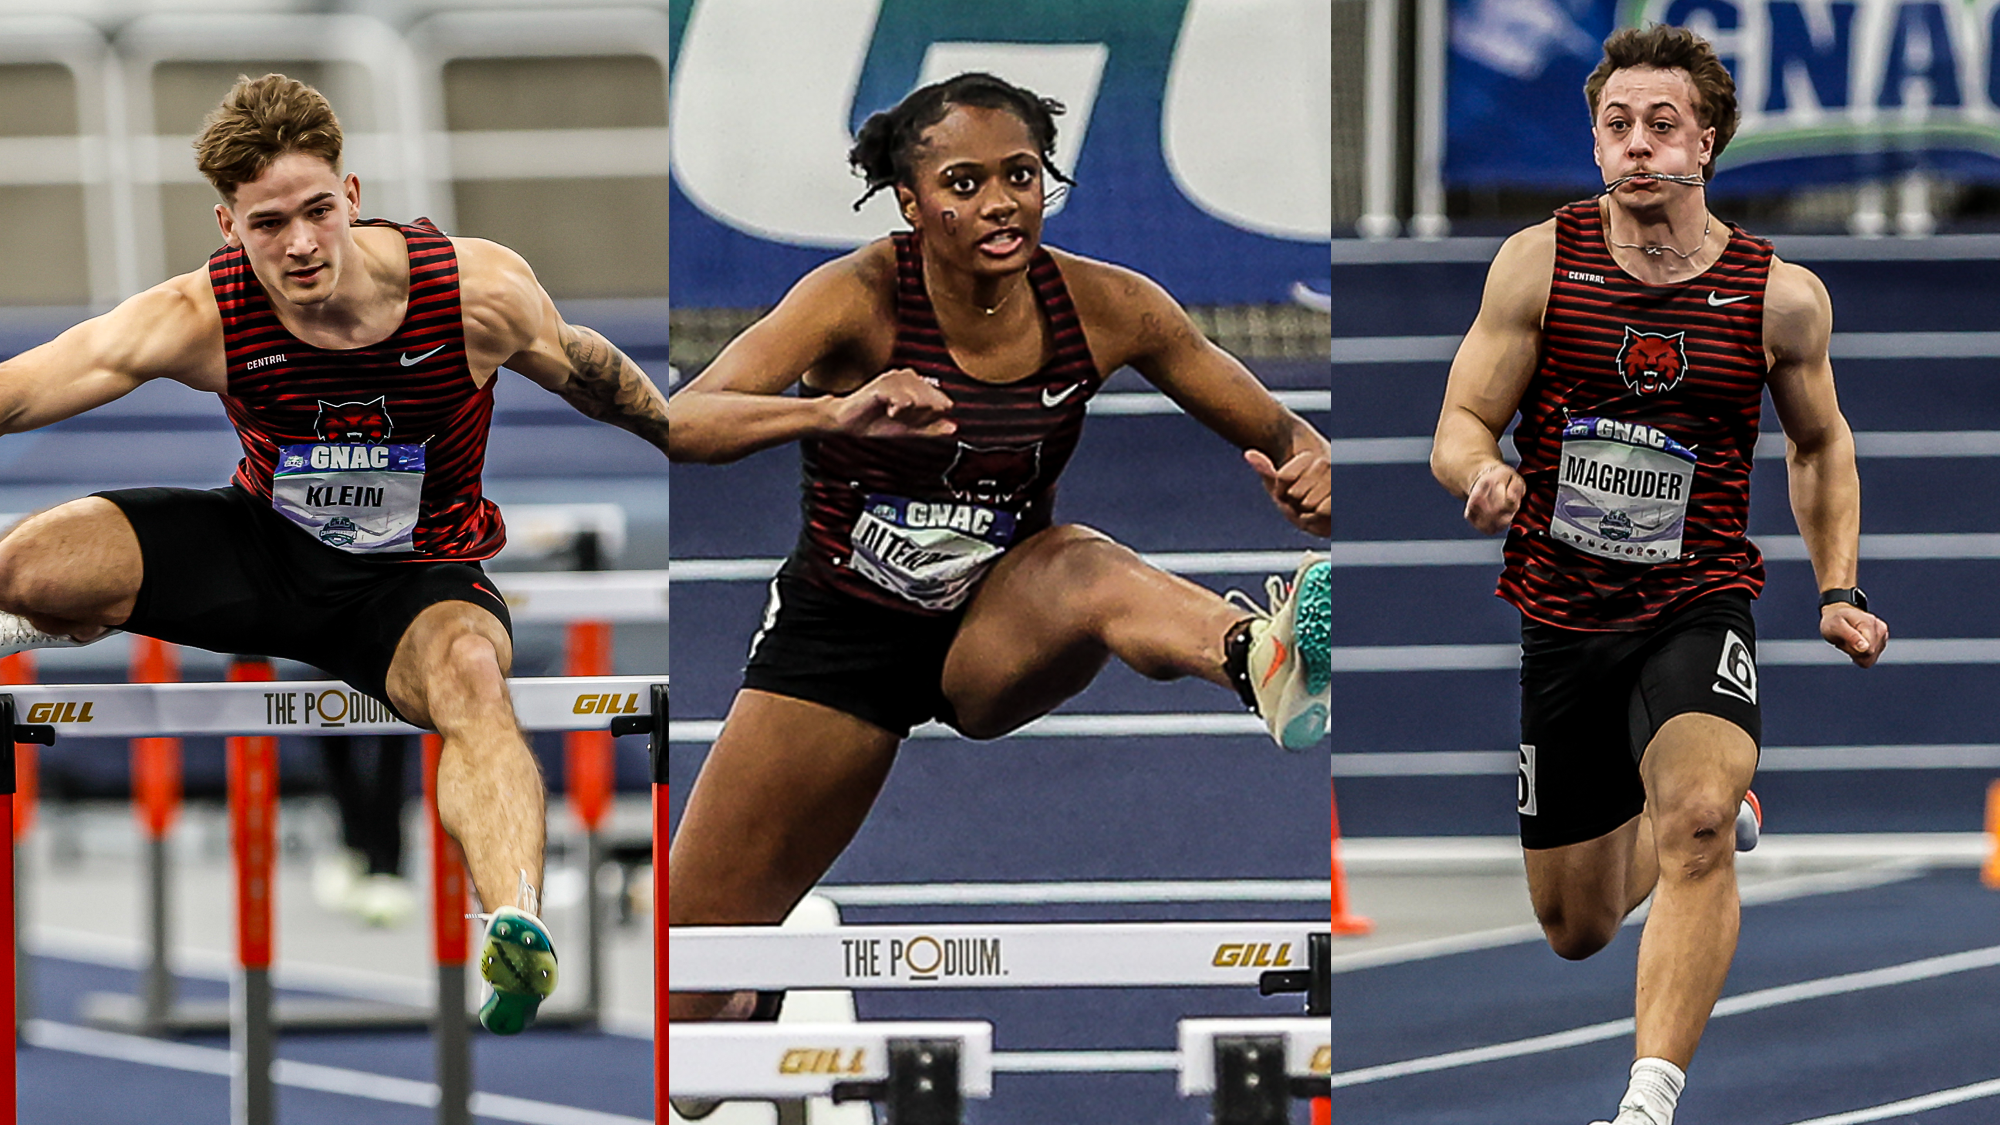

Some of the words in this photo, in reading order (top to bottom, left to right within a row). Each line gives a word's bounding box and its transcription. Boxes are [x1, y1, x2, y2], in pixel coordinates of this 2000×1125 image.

[1663, 0, 2000, 113] GNA
[1568, 271, 1606, 284] CENTRAL
[247, 353, 287, 370] CENTRAL
[1596, 418, 1666, 448] GNAC
[310, 445, 389, 469] GNAC
[1565, 455, 1683, 501] MAGRUDER
[305, 485, 384, 508] KLEIN
[906, 502, 994, 535] GNAC
[1727, 642, 1753, 690] 6
[27, 702, 94, 723] GILL
[264, 692, 298, 725] THE
[572, 693, 639, 714] GILL
[842, 939, 882, 977] THE
[1212, 943, 1292, 967] GILL
